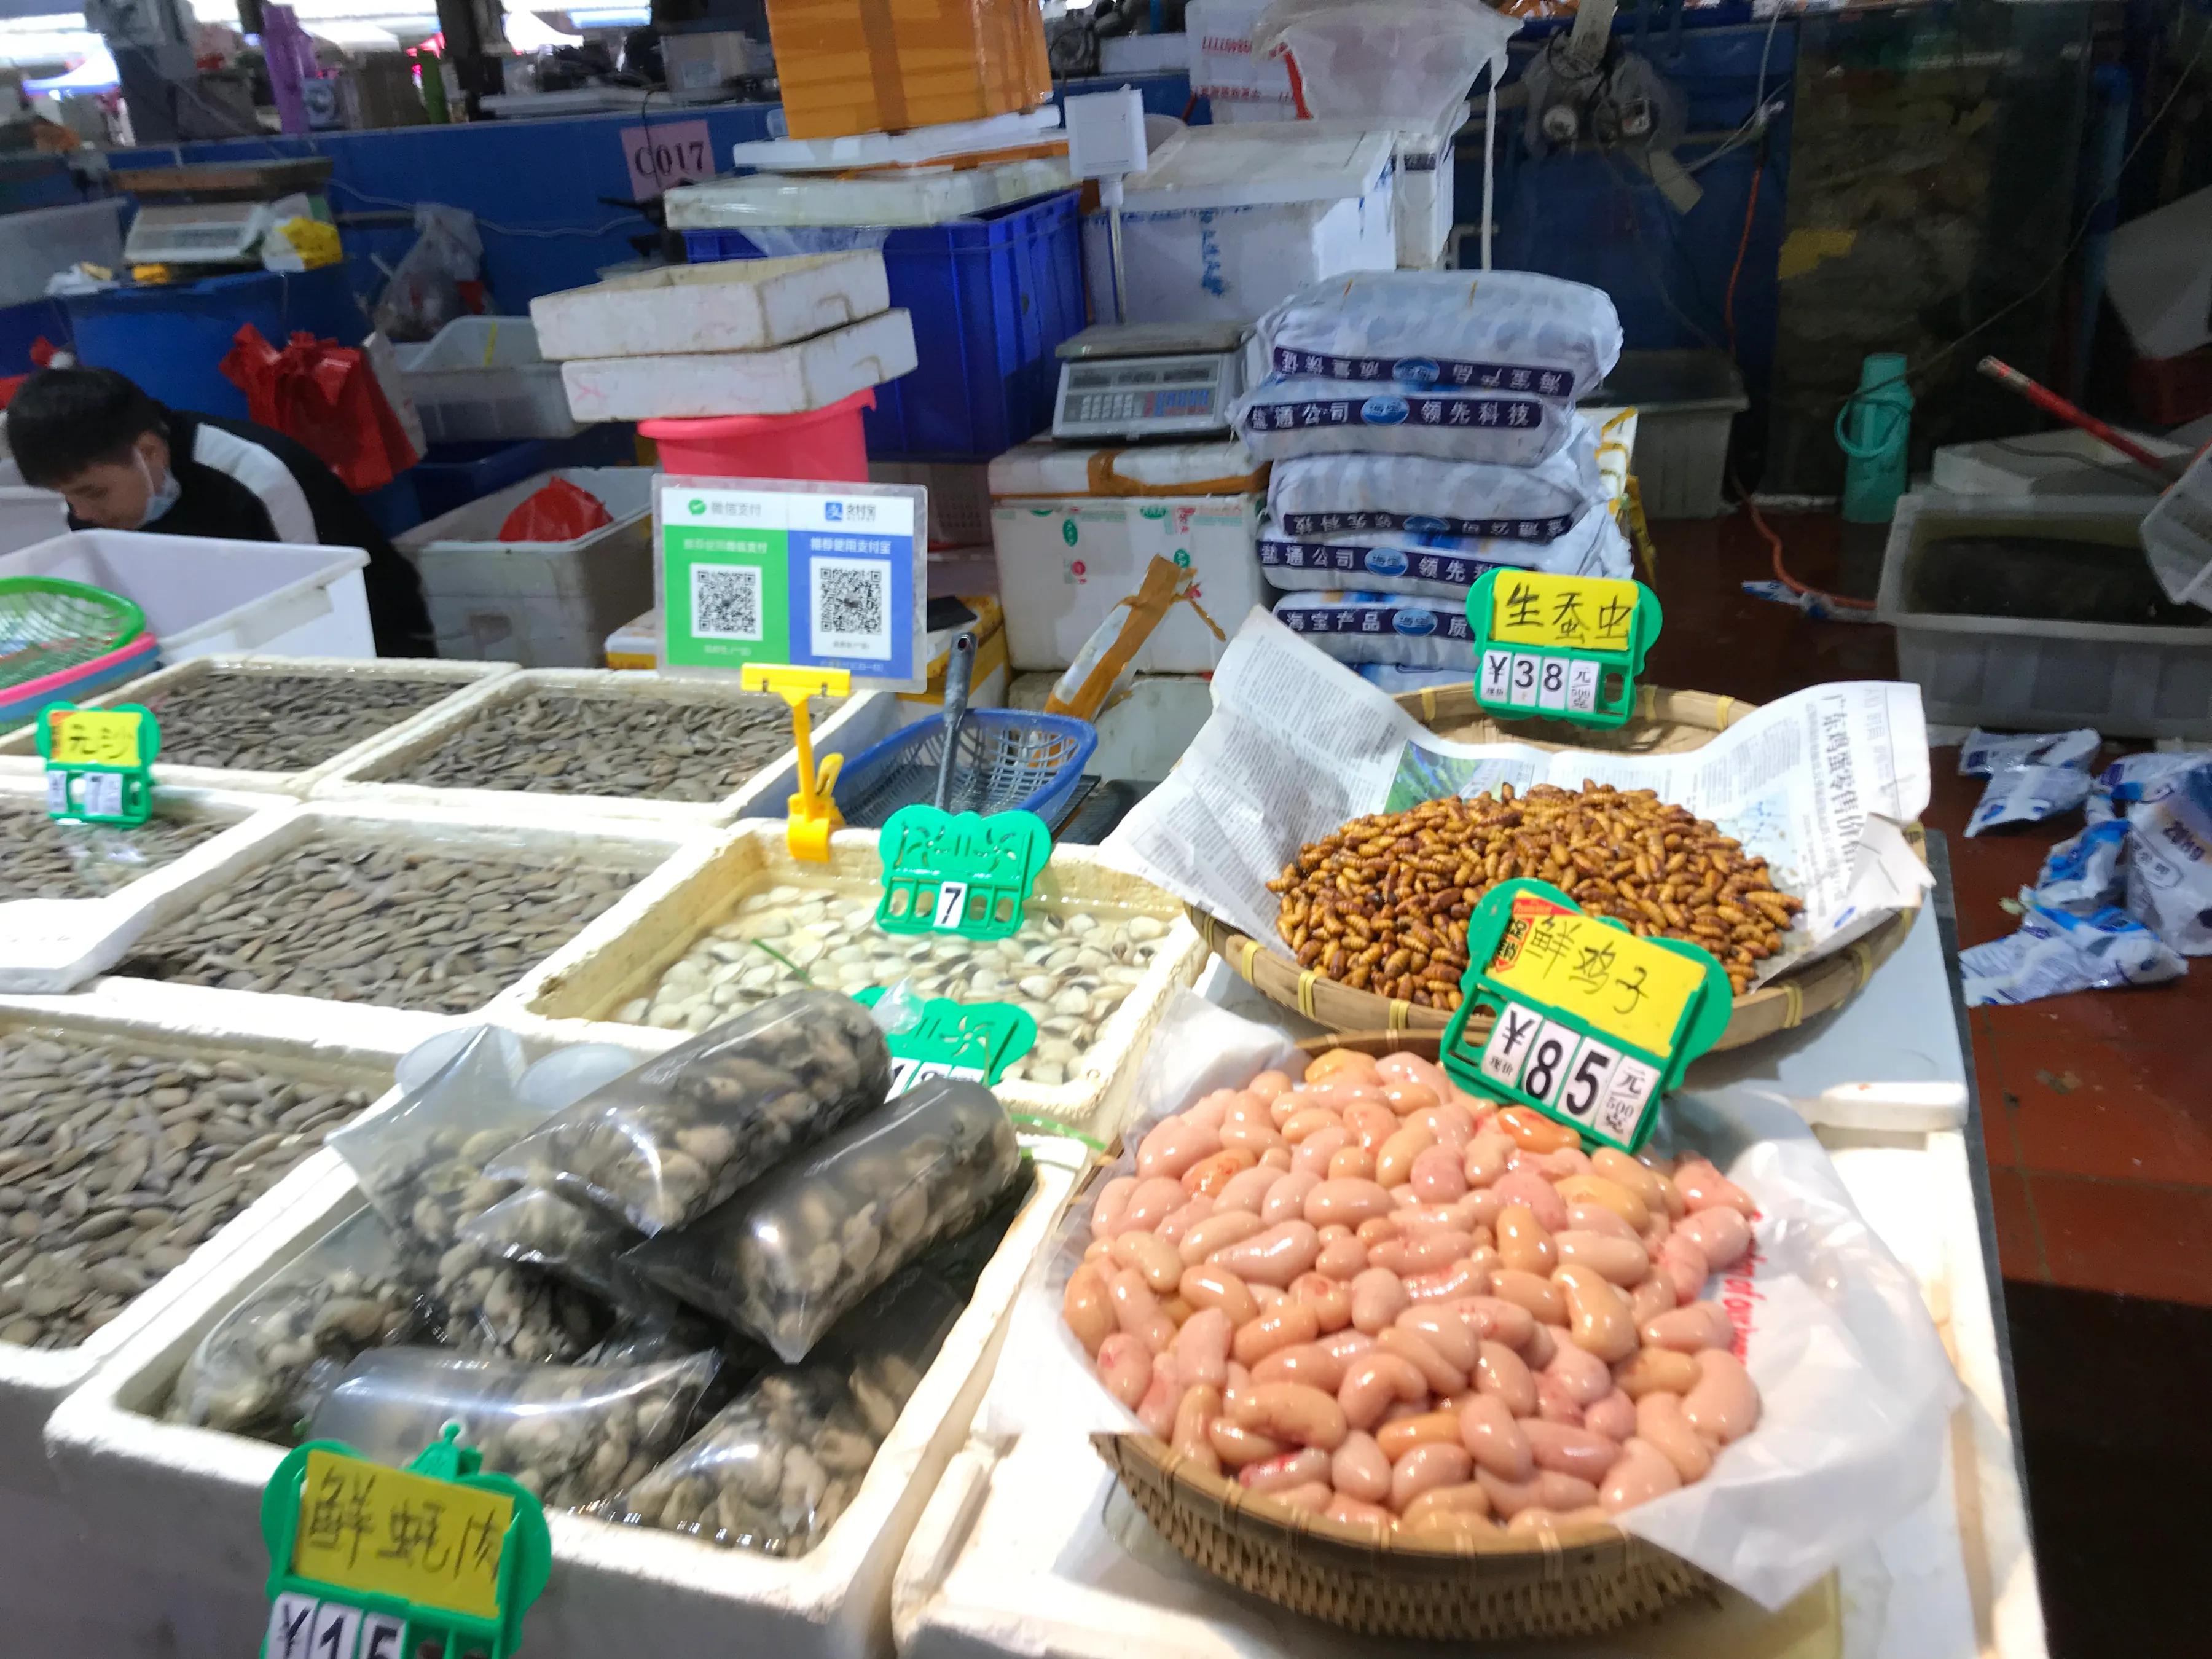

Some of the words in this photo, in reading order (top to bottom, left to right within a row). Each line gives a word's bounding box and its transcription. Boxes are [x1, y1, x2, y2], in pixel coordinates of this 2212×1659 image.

[635, 141, 704, 176] C017
[1421, 401, 1530, 428] 领先科技
[711, 501, 761, 517] 微信支付
[846, 503, 876, 516] 支付宝
[810, 536, 892, 554] 推荐使用支付宝
[1261, 544, 1354, 568] 盐通公司
[1371, 554, 1399, 568] 海宝
[1287, 611, 1380, 632] 海宝产品
[1400, 615, 1430, 628] 海宝
[942, 887, 963, 924] 7
